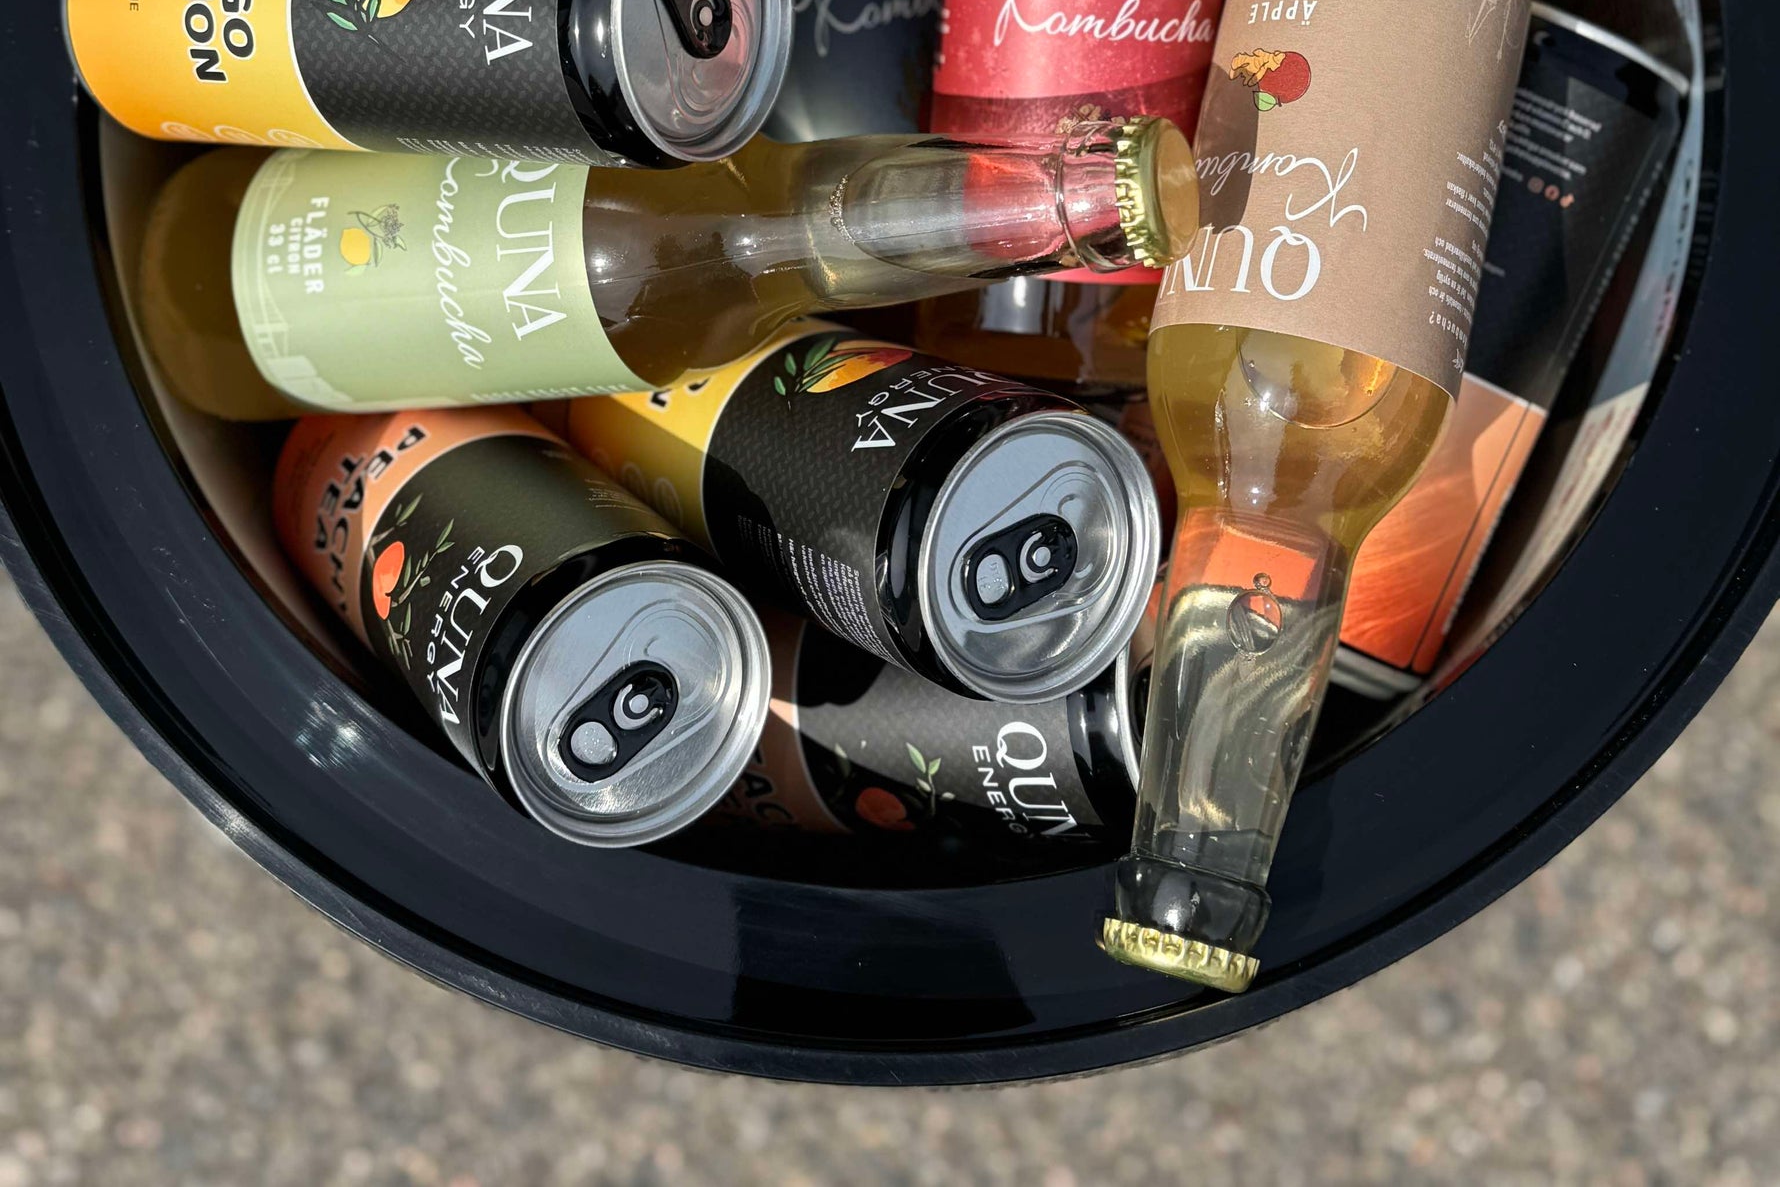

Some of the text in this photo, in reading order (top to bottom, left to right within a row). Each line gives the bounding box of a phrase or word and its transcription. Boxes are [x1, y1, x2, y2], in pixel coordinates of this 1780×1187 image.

[1248, 0, 1318, 26] ÄPPLE
[267, 224, 286, 247] 33
[288, 216, 304, 274] CITRON
[303, 197, 330, 294] FLÄDER
[315, 455, 364, 550] TEA
[330, 426, 427, 610] PEACH
[427, 545, 486, 693] ENERGY
[437, 544, 524, 725] QUNA
[972, 745, 1034, 838] ENERG
[996, 721, 1092, 839] QUN
